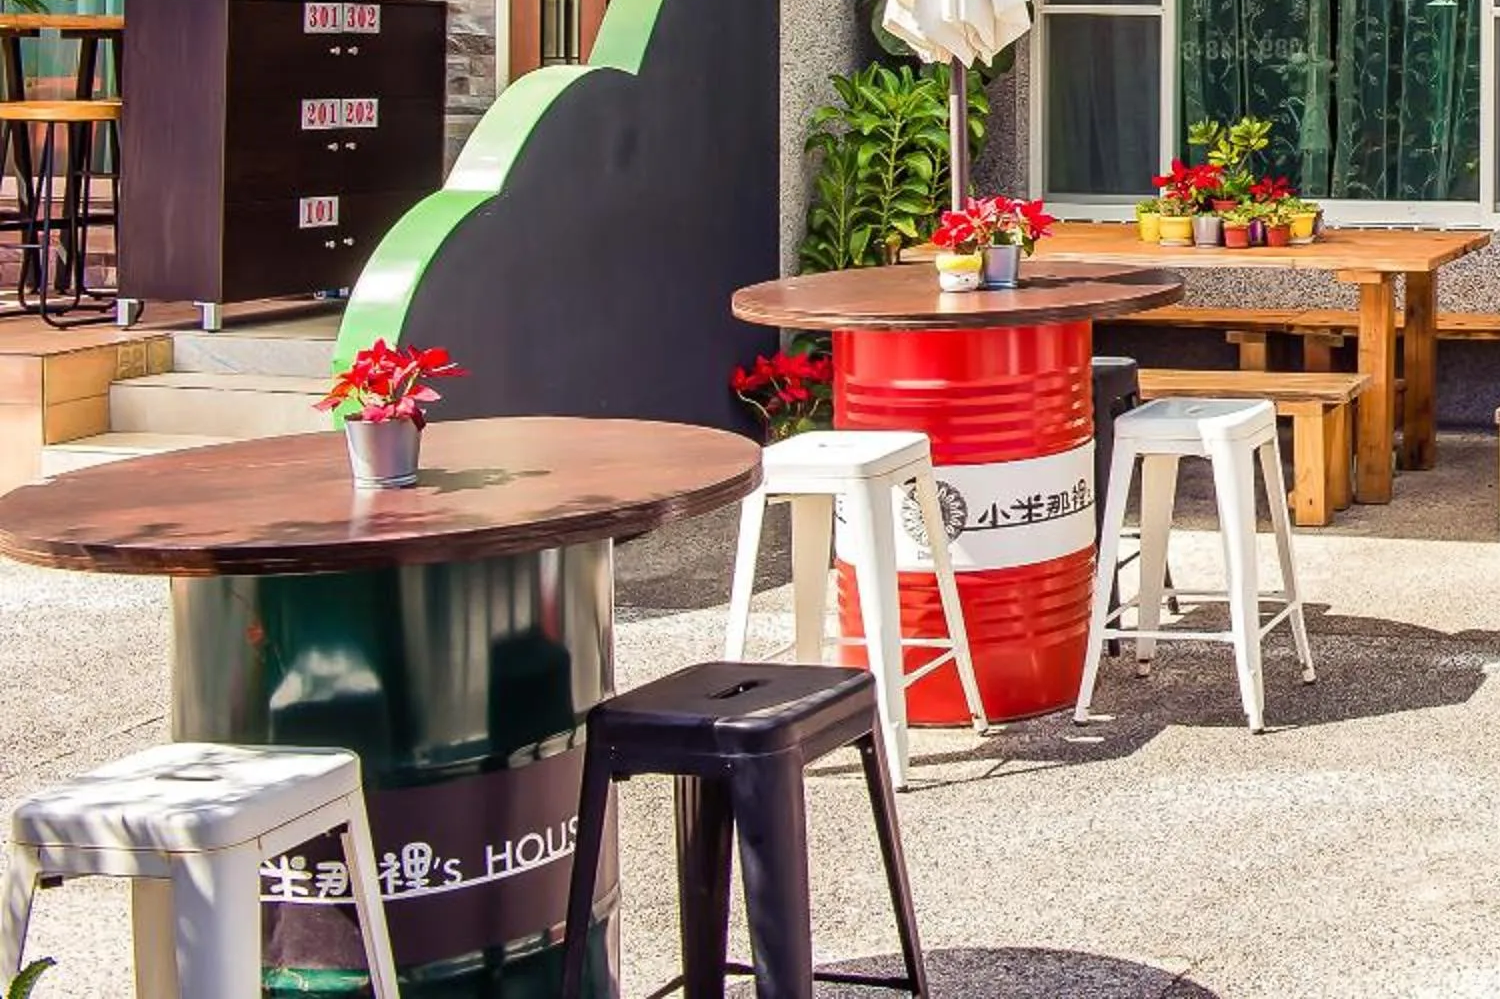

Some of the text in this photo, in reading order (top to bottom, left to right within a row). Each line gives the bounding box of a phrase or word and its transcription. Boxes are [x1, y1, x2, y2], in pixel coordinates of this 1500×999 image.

[309, 4, 337, 27] 301
[347, 5, 376, 27] 302
[307, 102, 336, 125] 201
[345, 101, 374, 123] 202
[306, 200, 333, 223] 101
